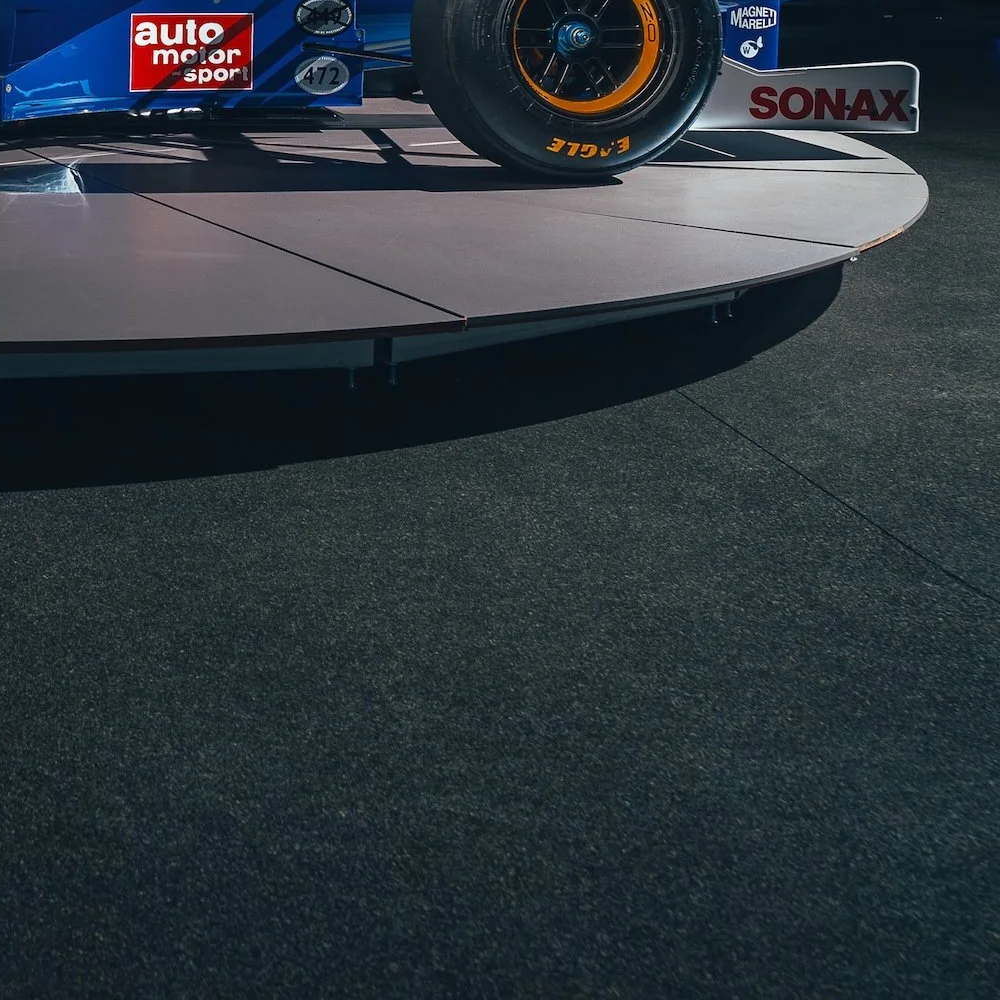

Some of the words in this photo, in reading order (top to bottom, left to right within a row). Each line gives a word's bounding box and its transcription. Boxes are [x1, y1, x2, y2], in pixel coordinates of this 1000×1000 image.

[731, 6, 777, 20] MAGNETI
[134, 19, 224, 46] auto
[731, 16, 777, 30] MARELLI
[152, 46, 242, 65] motor
[183, 66, 249, 84] sport
[303, 66, 340, 85] 472
[750, 86, 910, 122] SONAX
[546, 135, 632, 159] EAGLE
